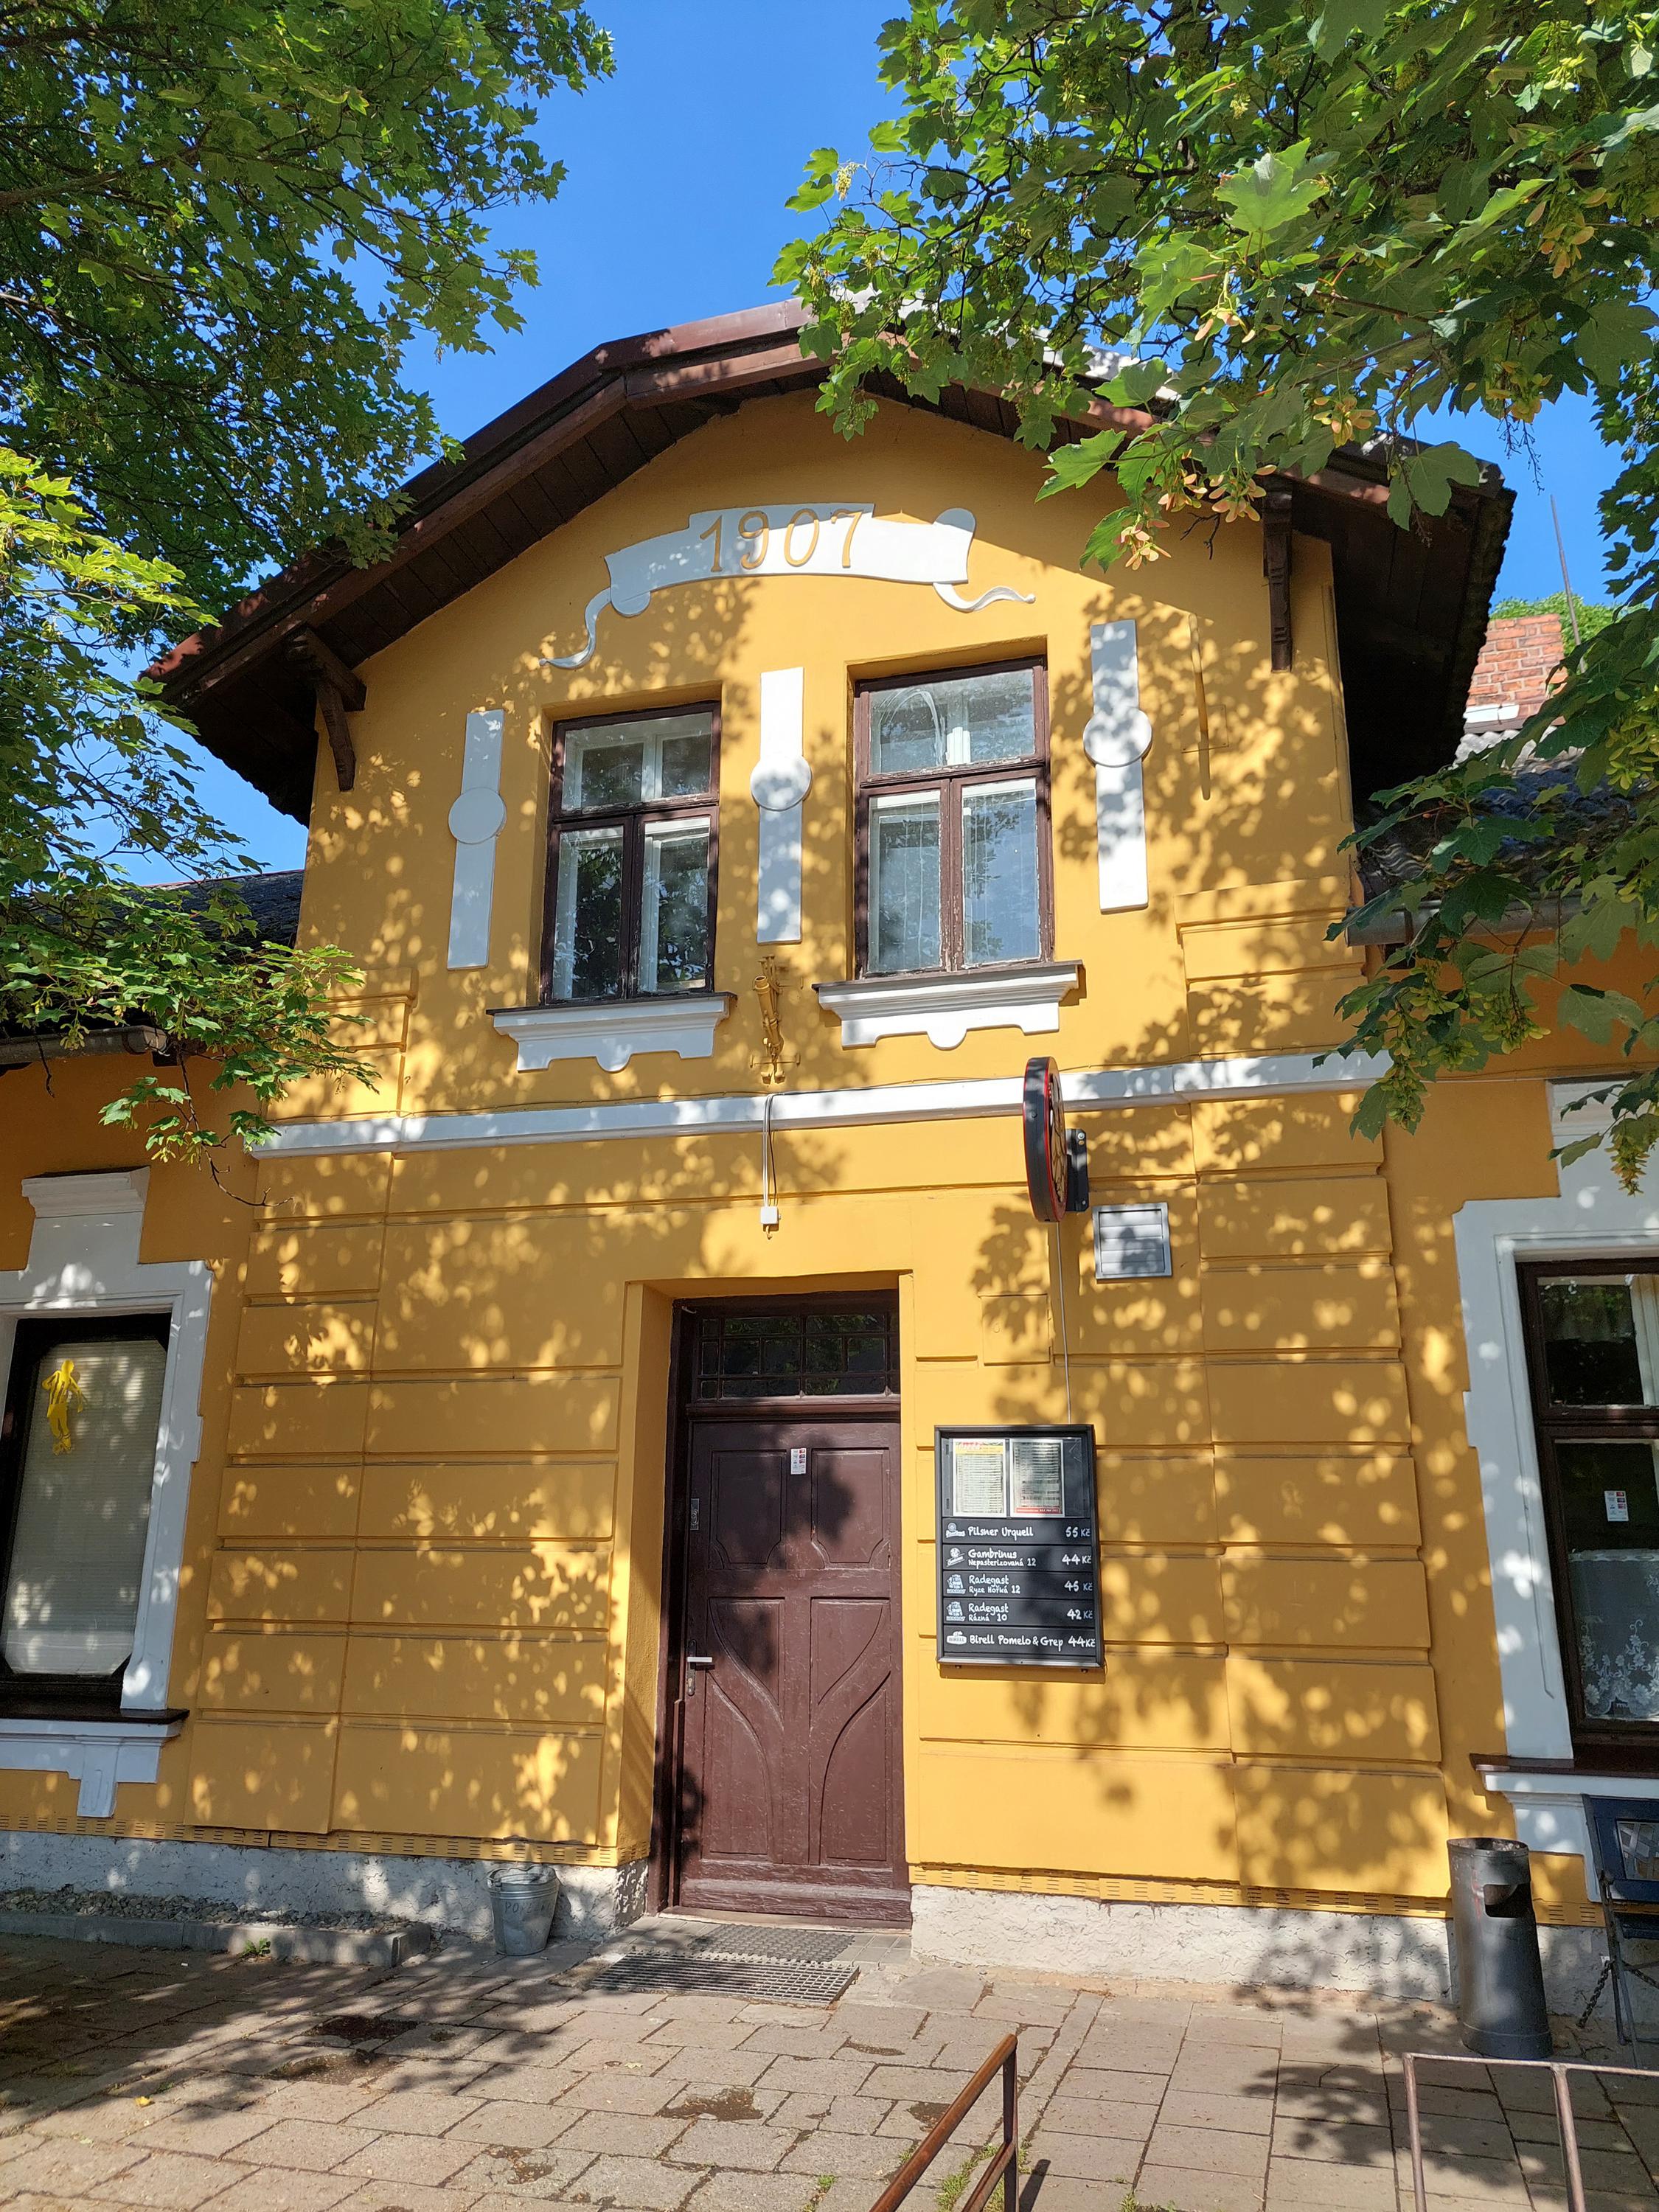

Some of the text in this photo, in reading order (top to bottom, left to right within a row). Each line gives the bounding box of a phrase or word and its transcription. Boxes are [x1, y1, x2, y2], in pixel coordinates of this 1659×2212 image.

[699, 508, 866, 573] 1907
[968, 1526, 998, 1536] Pilsner
[1001, 1526, 1034, 1541] Urquell
[1065, 1526, 1078, 1537] 55
[1080, 1528, 1091, 1537] Kč
[968, 1547, 1017, 1559] Gambrinus
[968, 1558, 1024, 1570] Nepasterizovaná
[1027, 1557, 1037, 1567] 12
[1062, 1554, 1092, 1565] 44 Kč
[969, 1573, 1009, 1587] Radegast
[1064, 1580, 1093, 1592] 45 Kč
[969, 1586, 985, 1596] Ryze
[988, 1585, 1009, 1593] Hořká
[1011, 1585, 1020, 1594] 12
[968, 1601, 1009, 1615] Radegast
[1067, 1608, 1093, 1620] 42 Kč
[968, 1613, 990, 1621] Rázná
[997, 1613, 1008, 1621] 10
[970, 1634, 995, 1644] Birell
[998, 1634, 1032, 1645] Pomelo
[1040, 1636, 1063, 1652] Grep
